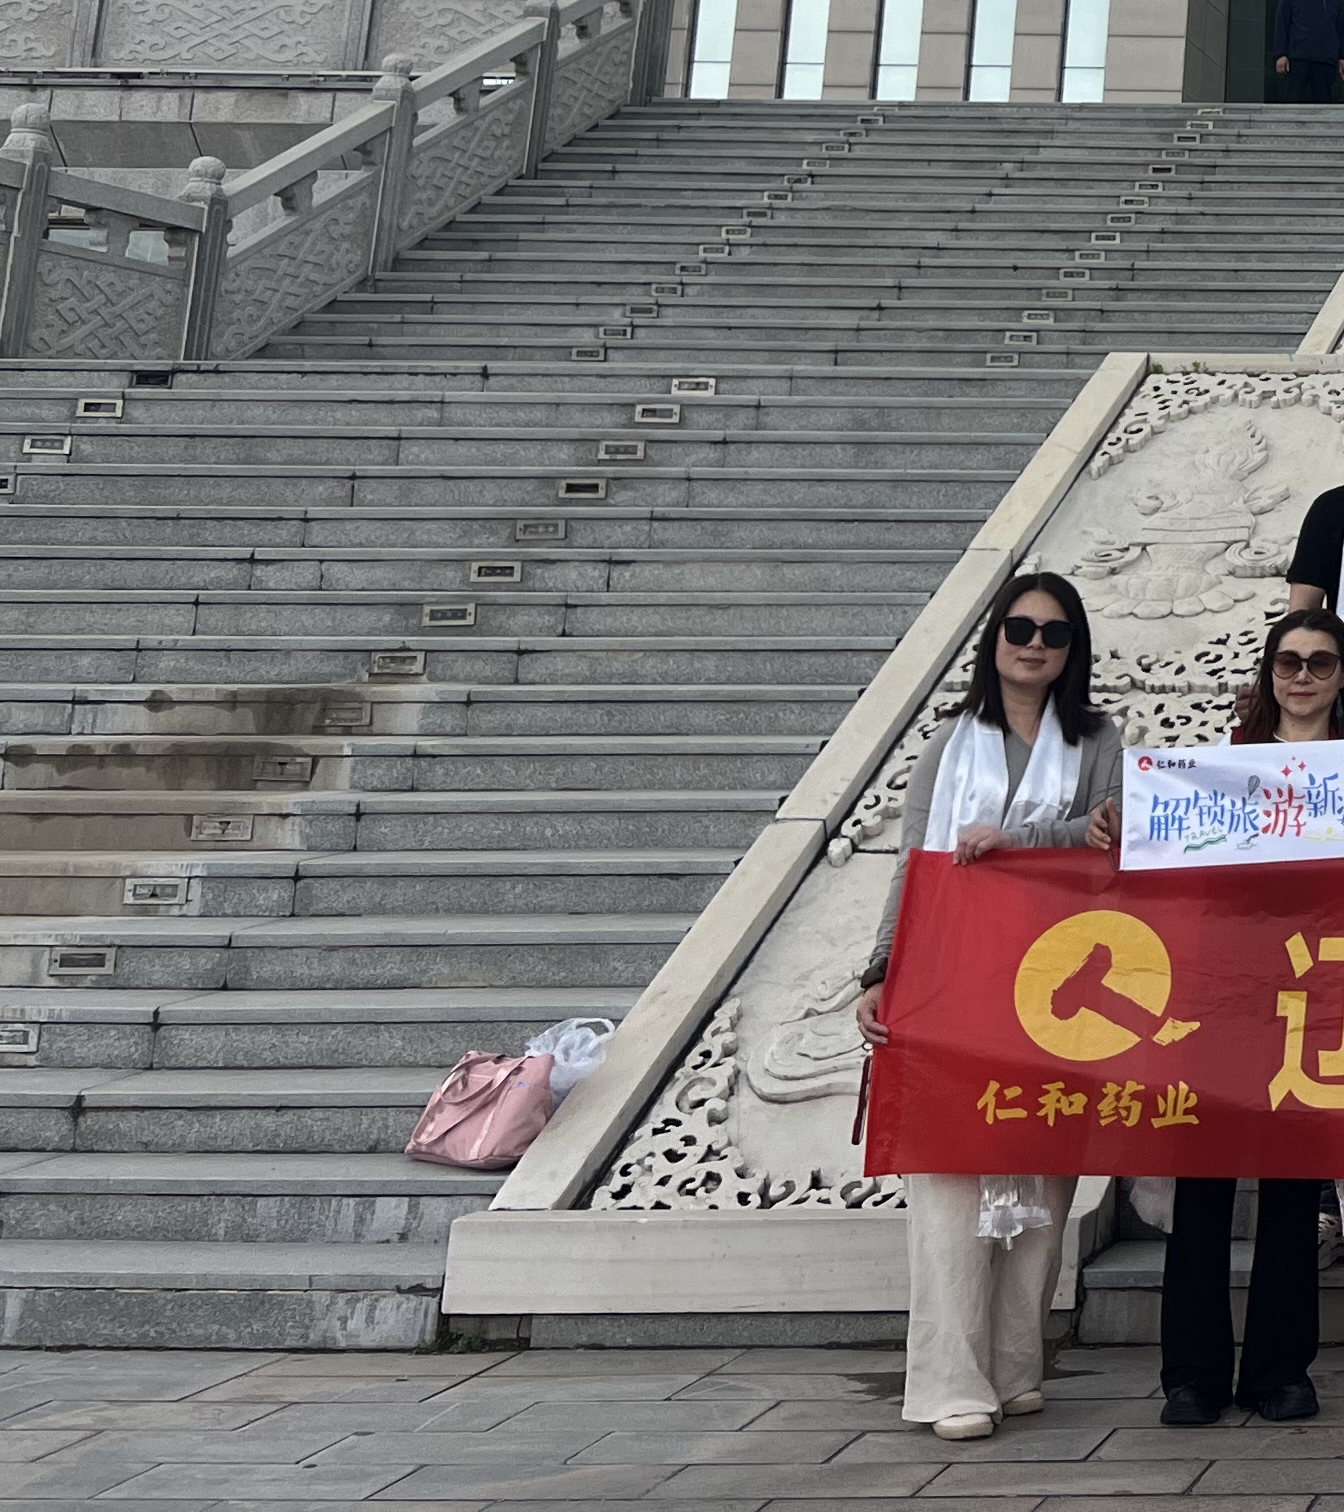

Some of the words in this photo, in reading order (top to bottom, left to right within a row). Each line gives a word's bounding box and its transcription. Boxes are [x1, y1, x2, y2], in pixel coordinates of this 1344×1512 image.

[1156, 756, 1197, 771] 仁和药业
[1184, 826, 1224, 841] TRAVEL
[978, 1079, 1200, 1129] 仁和药业
